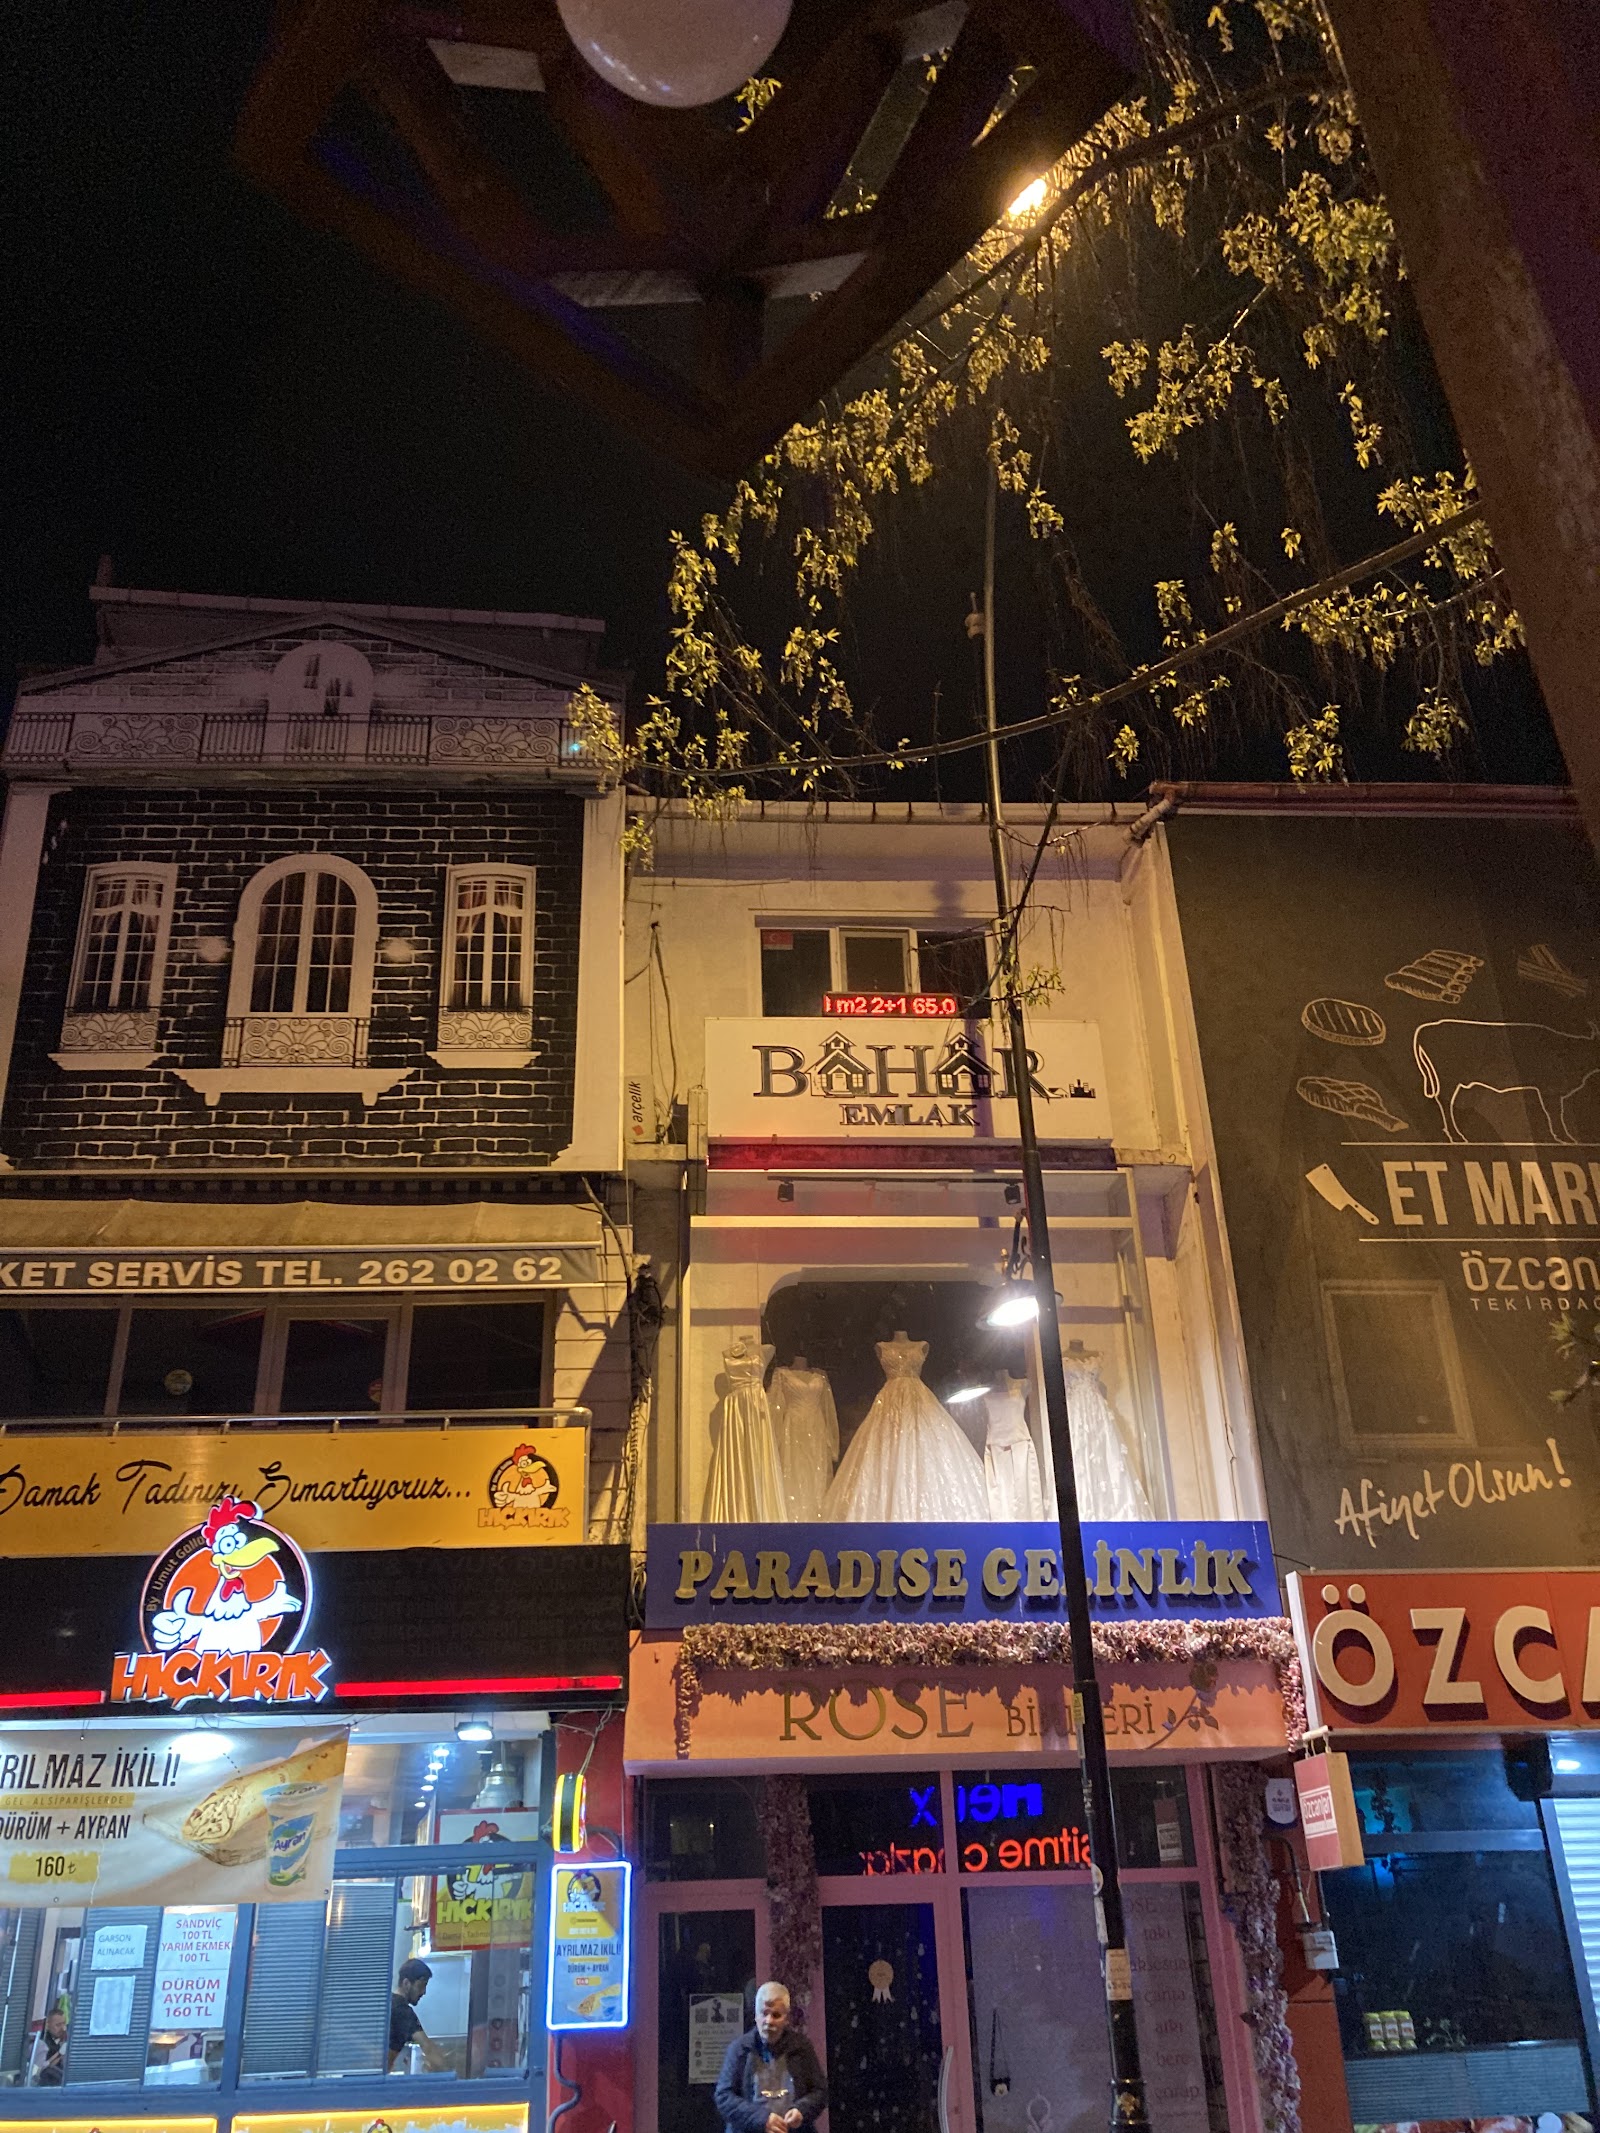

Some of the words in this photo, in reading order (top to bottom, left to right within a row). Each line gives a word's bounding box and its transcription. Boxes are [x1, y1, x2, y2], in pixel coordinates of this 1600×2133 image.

[836, 996, 868, 1014] m2
[871, 996, 907, 1014] 2+1
[911, 997, 957, 1015] 65.0
[839, 1103, 980, 1127] EMLAK
[1382, 1161, 1449, 1226] ET
[1463, 1161, 1600, 1226] MAR
[87, 1255, 244, 1288] SERVİS
[256, 1260, 342, 1286] TEL.
[357, 1259, 435, 1285] 262
[448, 1258, 499, 1283] 02
[512, 1257, 563, 1282] 62
[1334, 1469, 1445, 1549] Afiyet
[1449, 1437, 1572, 1509] Olsun!
[152, 1557, 179, 1591] Umut
[675, 1548, 969, 1598] PARADISE
[982, 1539, 1253, 1598] GEİNLİK
[110, 1649, 330, 1710] HIÇKIRIK
[778, 1679, 974, 1741] ROSE
[0, 1753, 107, 1790] RILMAZ
[111, 1746, 181, 1788] İKİLİ!
[74, 1814, 132, 1840] AYRAN
[273, 1831, 307, 1852] Ayran
[175, 1917, 222, 1930] SANDVİÇ
[99, 1934, 131, 1943] GARSON
[182, 1931, 200, 1940] 100
[202, 1930, 214, 1940] TL
[97, 1947, 136, 1956] ALINACAK
[161, 1942, 193, 1952] YARIM
[195, 1941, 231, 1951] EKMEK
[179, 1953, 197, 1963] 100
[199, 1952, 211, 1962] TL
[161, 1976, 221, 1991] DÜRÜM
[163, 1992, 216, 2005] AYRAN
[165, 2006, 192, 2018] 160
[195, 2005, 213, 2017] TL
